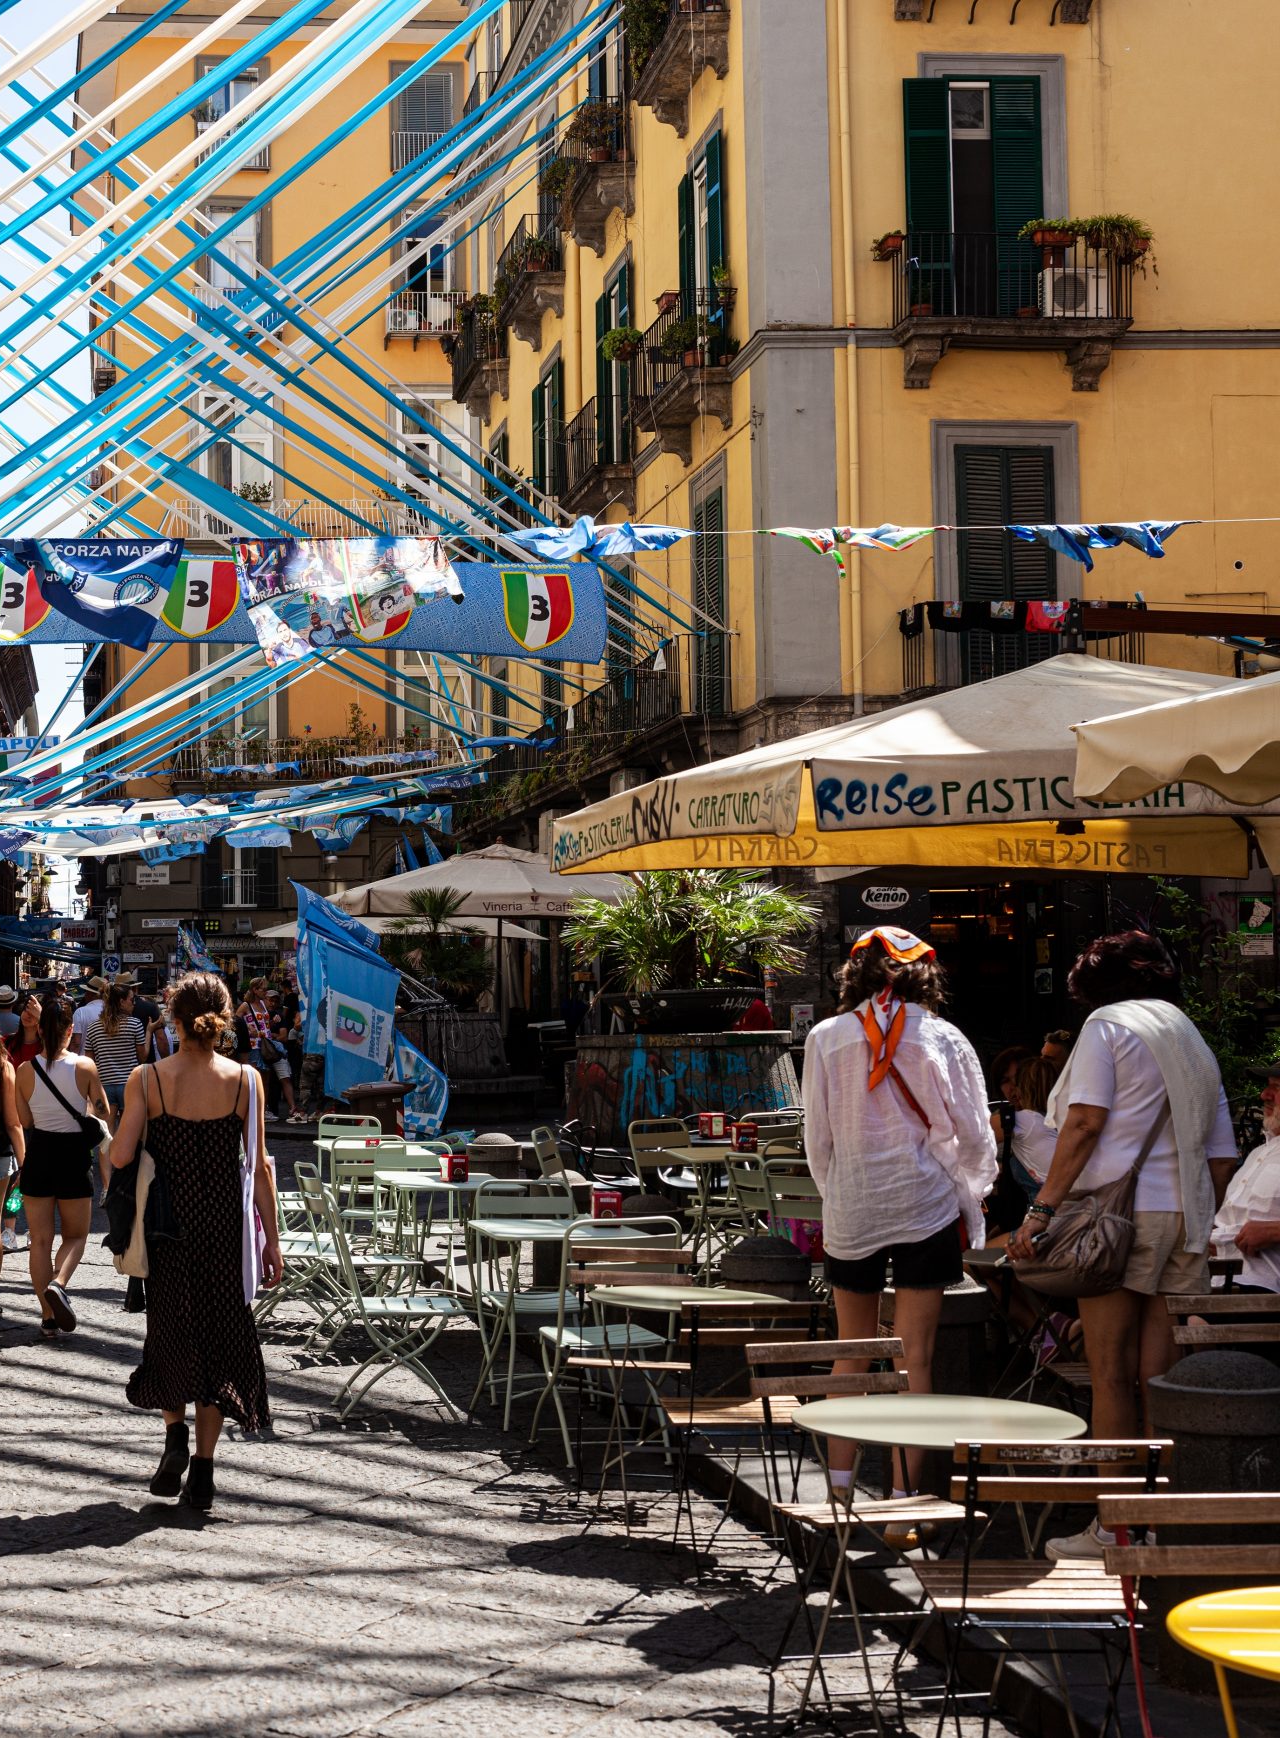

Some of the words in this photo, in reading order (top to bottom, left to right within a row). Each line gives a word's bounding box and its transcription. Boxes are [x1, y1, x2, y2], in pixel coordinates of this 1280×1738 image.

[54, 545, 111, 558] FORZA
[116, 542, 179, 557] NAPLI
[186, 580, 210, 608] 3
[530, 594, 550, 621] 3
[688, 790, 761, 829] CARRATURO
[482, 900, 524, 912] Vineria
[864, 888, 908, 903] kenon
